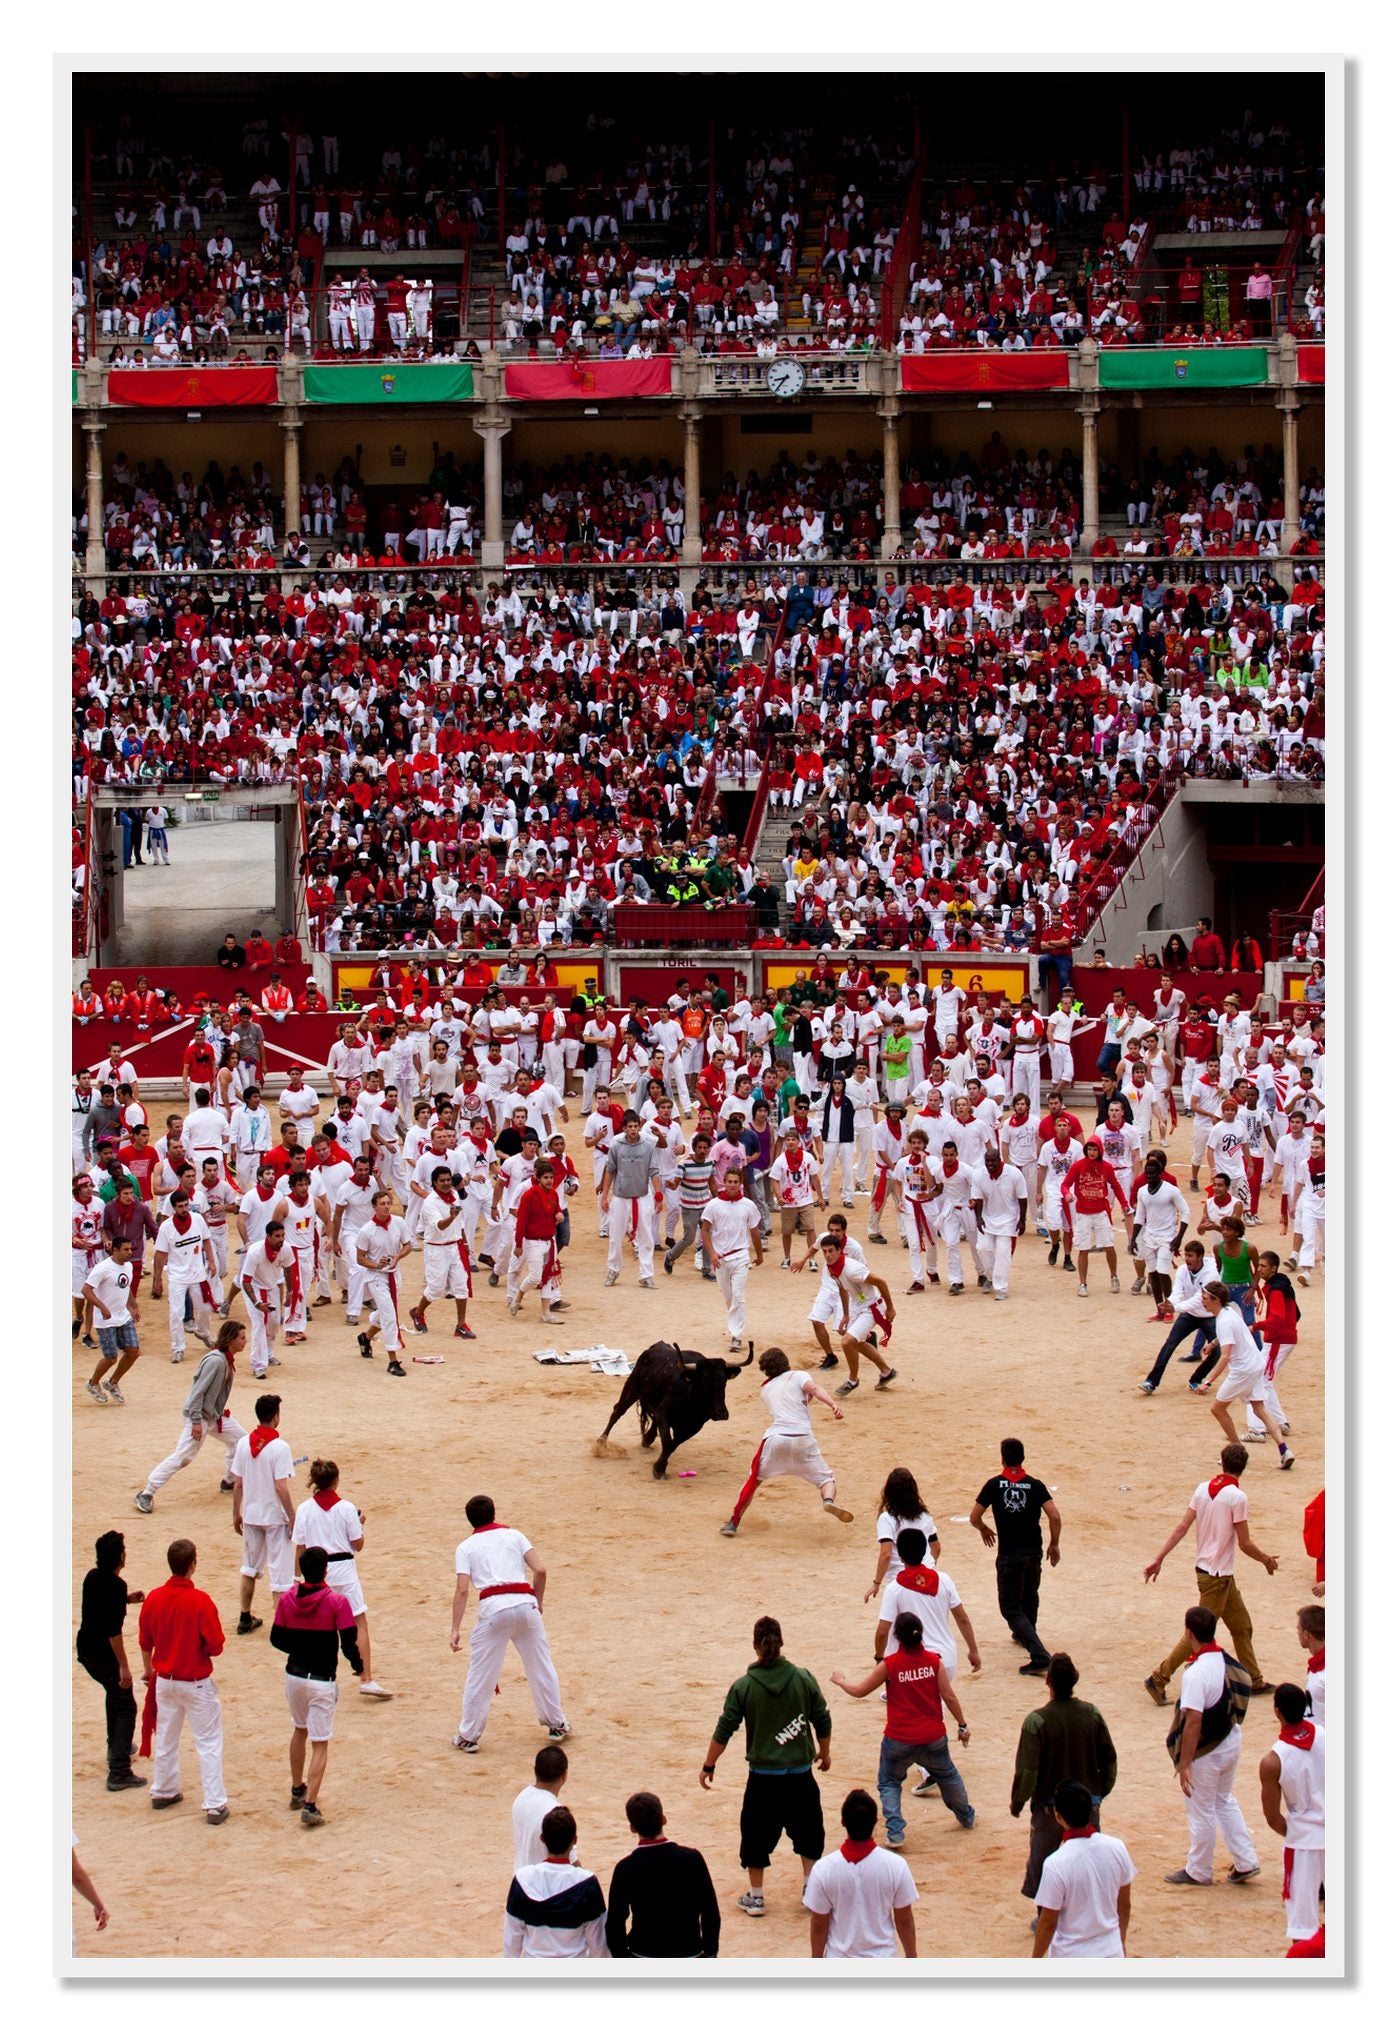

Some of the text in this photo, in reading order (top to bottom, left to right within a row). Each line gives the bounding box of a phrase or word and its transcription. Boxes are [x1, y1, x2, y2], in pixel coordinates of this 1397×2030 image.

[662, 959, 697, 967] TORIL
[969, 974, 984, 991] 6
[898, 1665, 935, 1683] GALLEGA
[774, 1713, 807, 1745] INEFC
